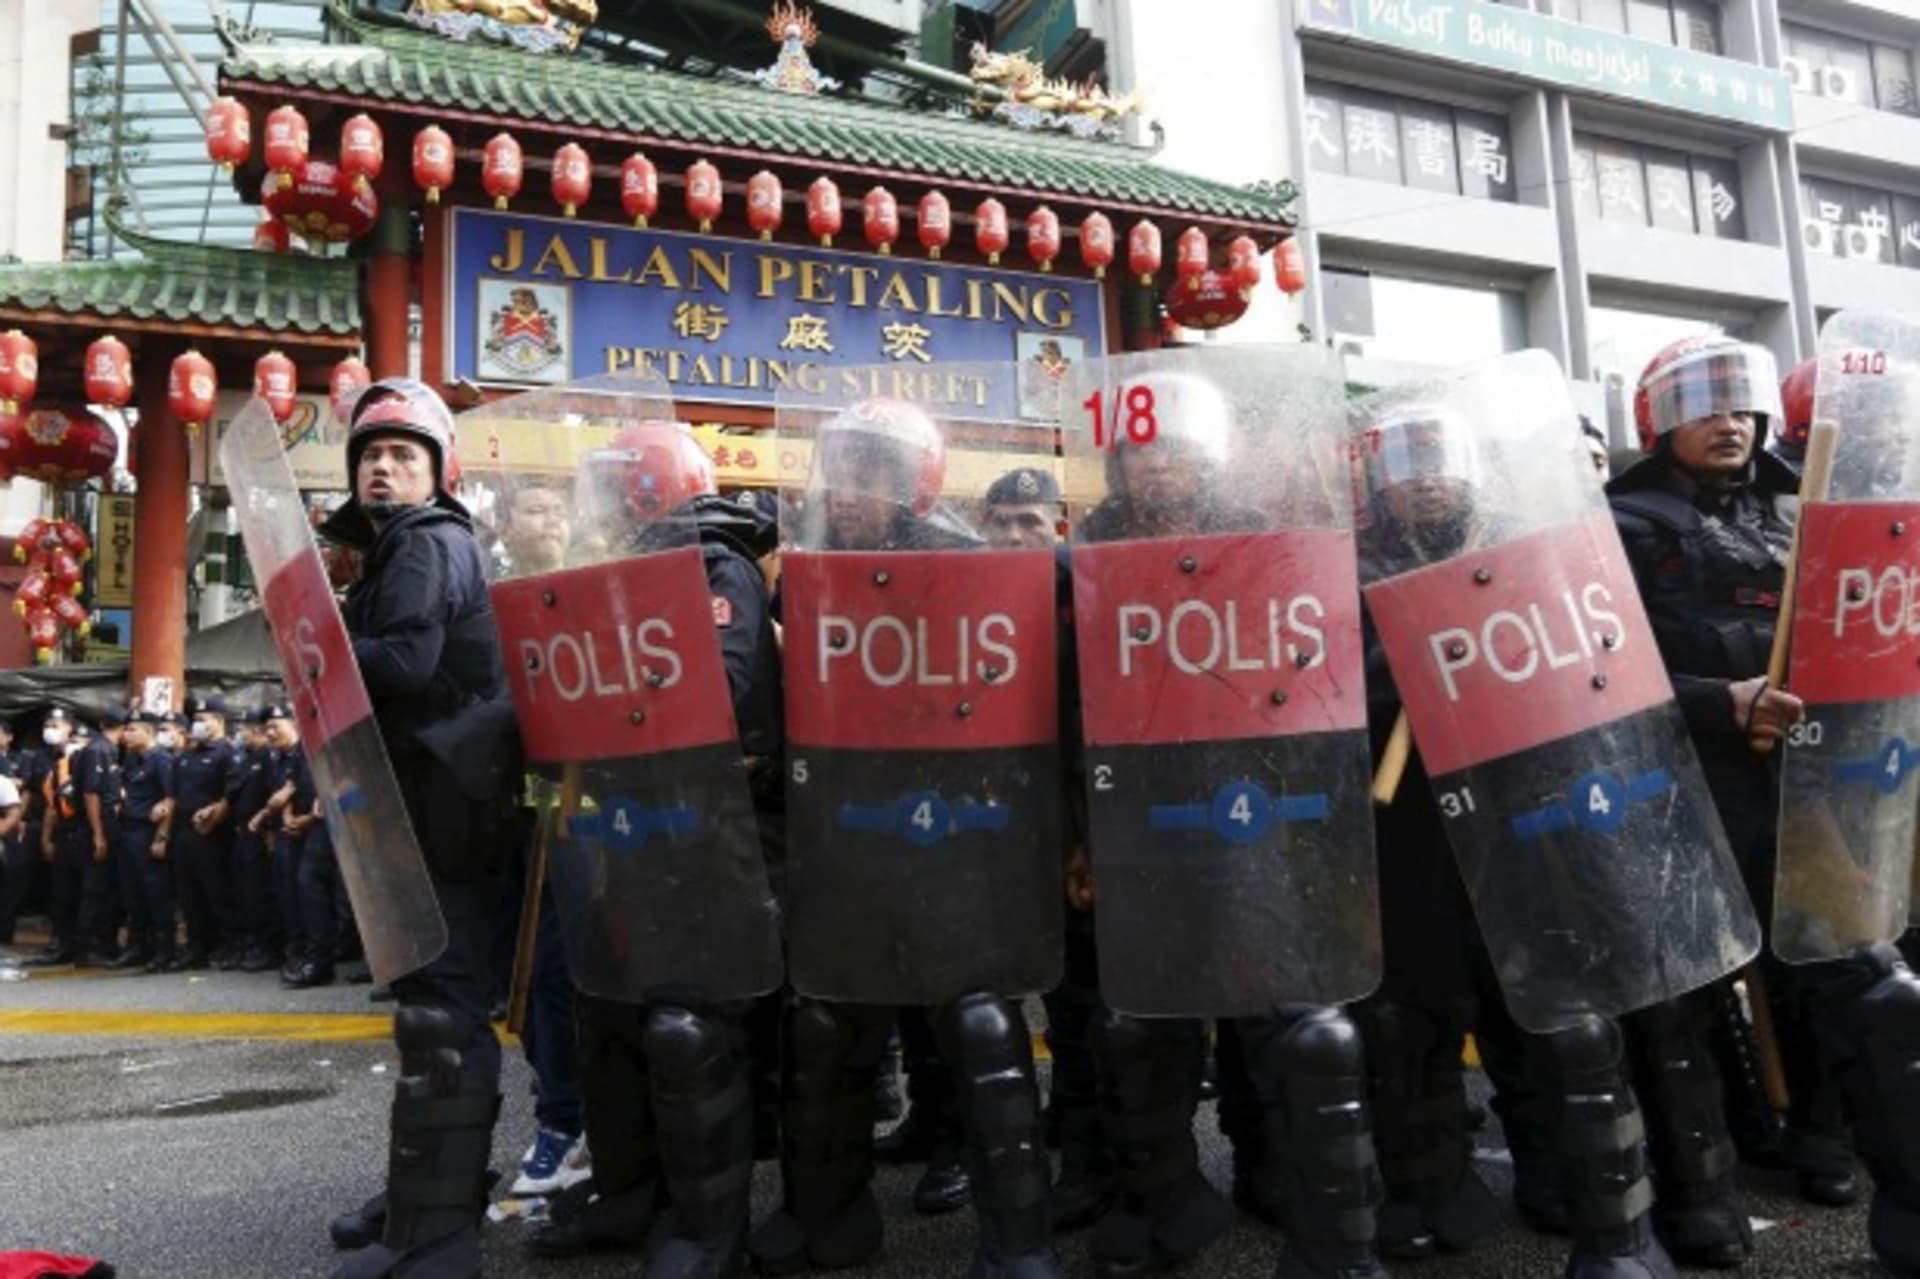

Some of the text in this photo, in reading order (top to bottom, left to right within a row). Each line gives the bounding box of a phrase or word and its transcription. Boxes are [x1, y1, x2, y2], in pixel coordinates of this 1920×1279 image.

[490, 229, 1073, 328] JALAN PETALING
[604, 345, 827, 395] PETALING
[841, 370, 990, 406] STREET
[1083, 385, 1157, 454] 1/8
[112, 521, 132, 590] HOTEL
[818, 613, 1018, 687] POLIS
[1118, 594, 1326, 676] POLIS
[1428, 582, 1626, 702] POLIS
[519, 617, 683, 704] POLIS
[1788, 721, 1823, 746] 30
[792, 760, 809, 783] 5
[1094, 765, 1114, 790] 2
[1885, 747, 1900, 777] 4
[1229, 793, 1253, 825] 4
[1440, 786, 1476, 818] 31
[1588, 783, 1611, 814] 4
[612, 807, 632, 836] 4
[911, 801, 934, 831] 4
